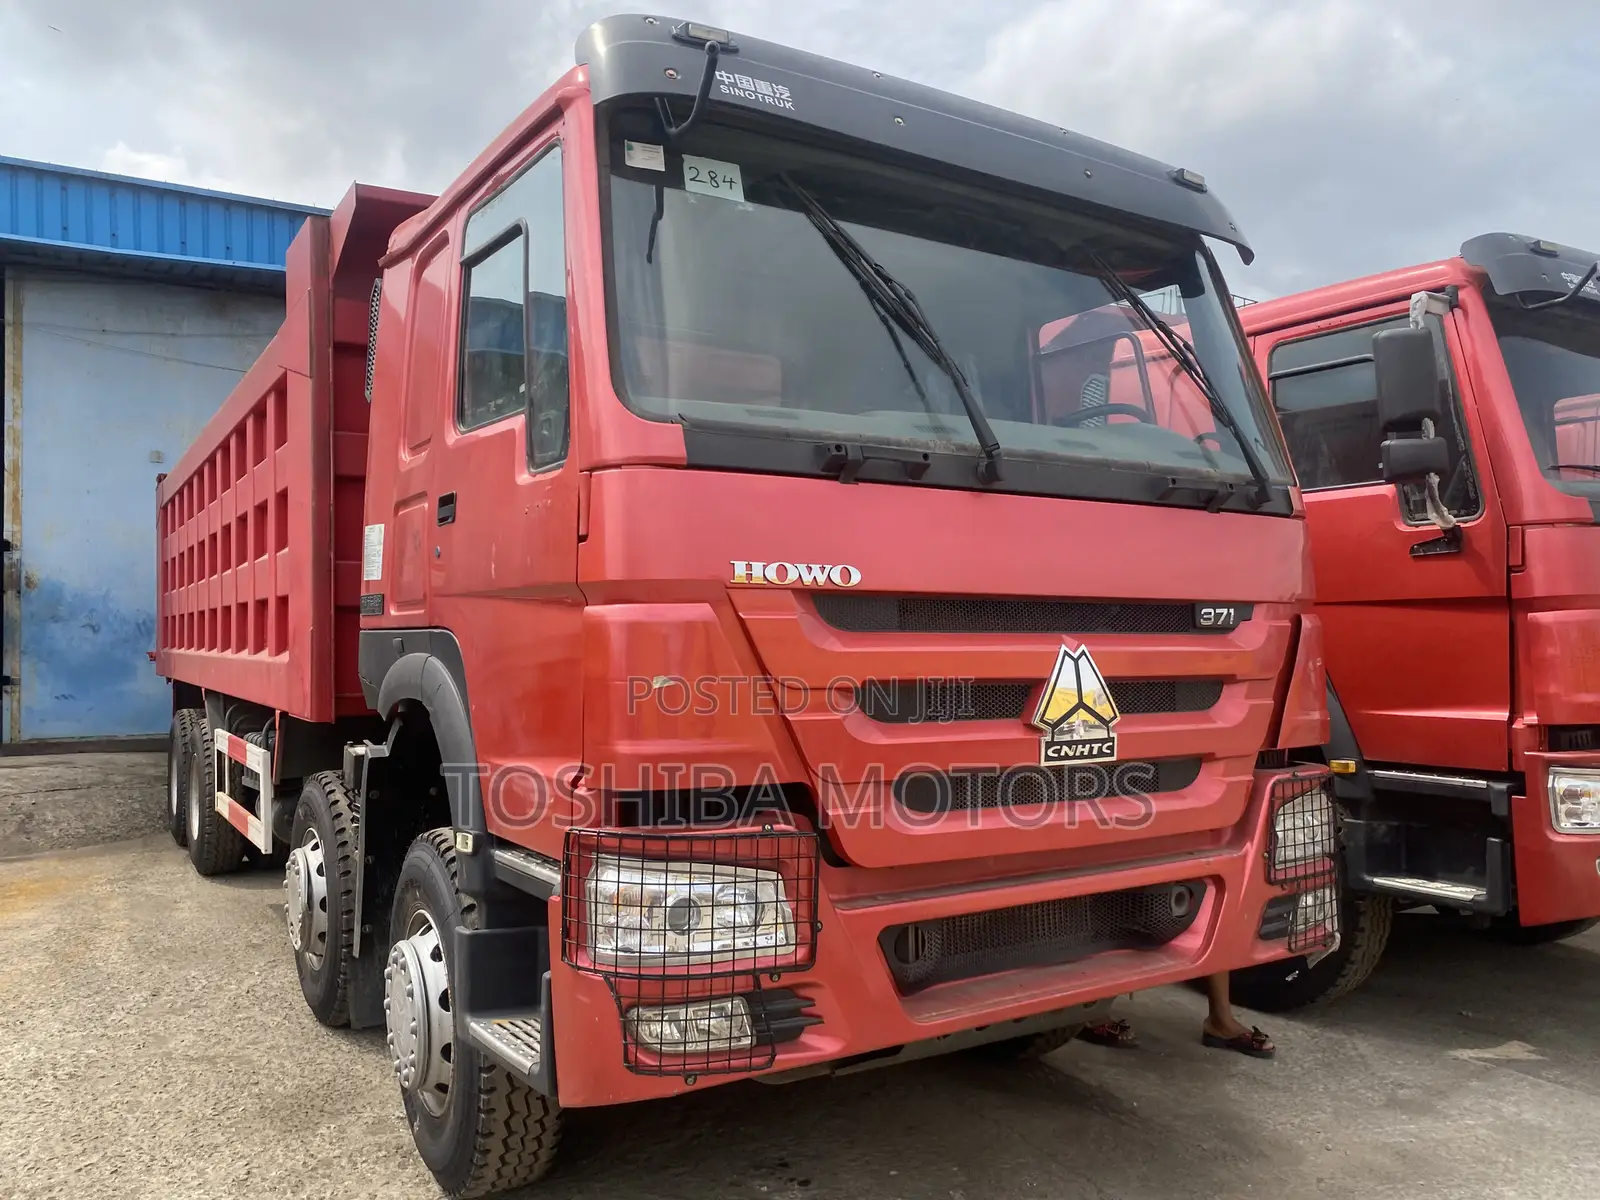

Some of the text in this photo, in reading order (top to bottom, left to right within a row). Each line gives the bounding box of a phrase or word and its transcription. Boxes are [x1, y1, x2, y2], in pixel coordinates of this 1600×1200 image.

[715, 70, 793, 101] 中国重汽
[720, 84, 795, 111] SINOTRUK
[688, 166, 737, 190] 284
[730, 560, 862, 587] HOWO
[1200, 608, 1235, 626] 371
[1047, 742, 1113, 757] CNHTC
